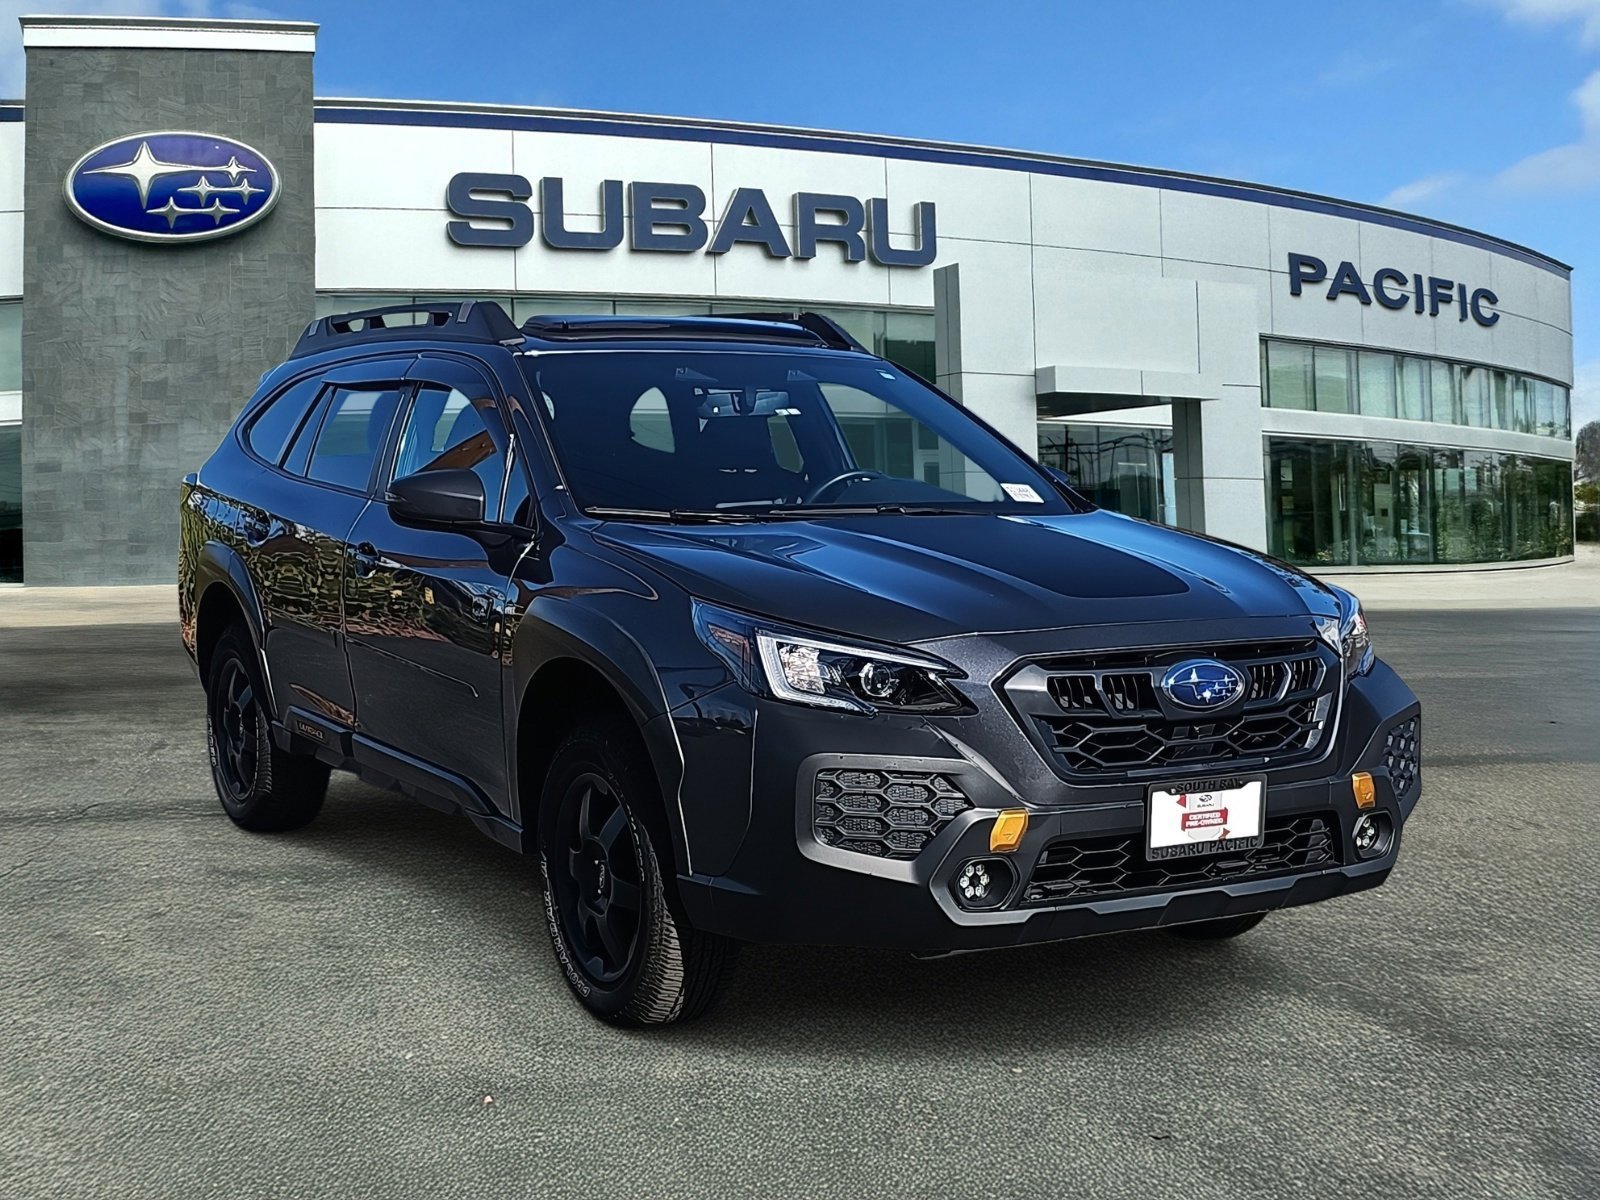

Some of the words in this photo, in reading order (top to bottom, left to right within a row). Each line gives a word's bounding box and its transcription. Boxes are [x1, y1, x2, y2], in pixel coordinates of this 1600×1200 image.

[446, 172, 937, 267] SUBARU
[1288, 252, 1500, 327] PACIFIC
[1176, 780, 1216, 792] SOUTH
[1151, 843, 1204, 860] SUBARU
[1209, 837, 1258, 854] PACIFIC
